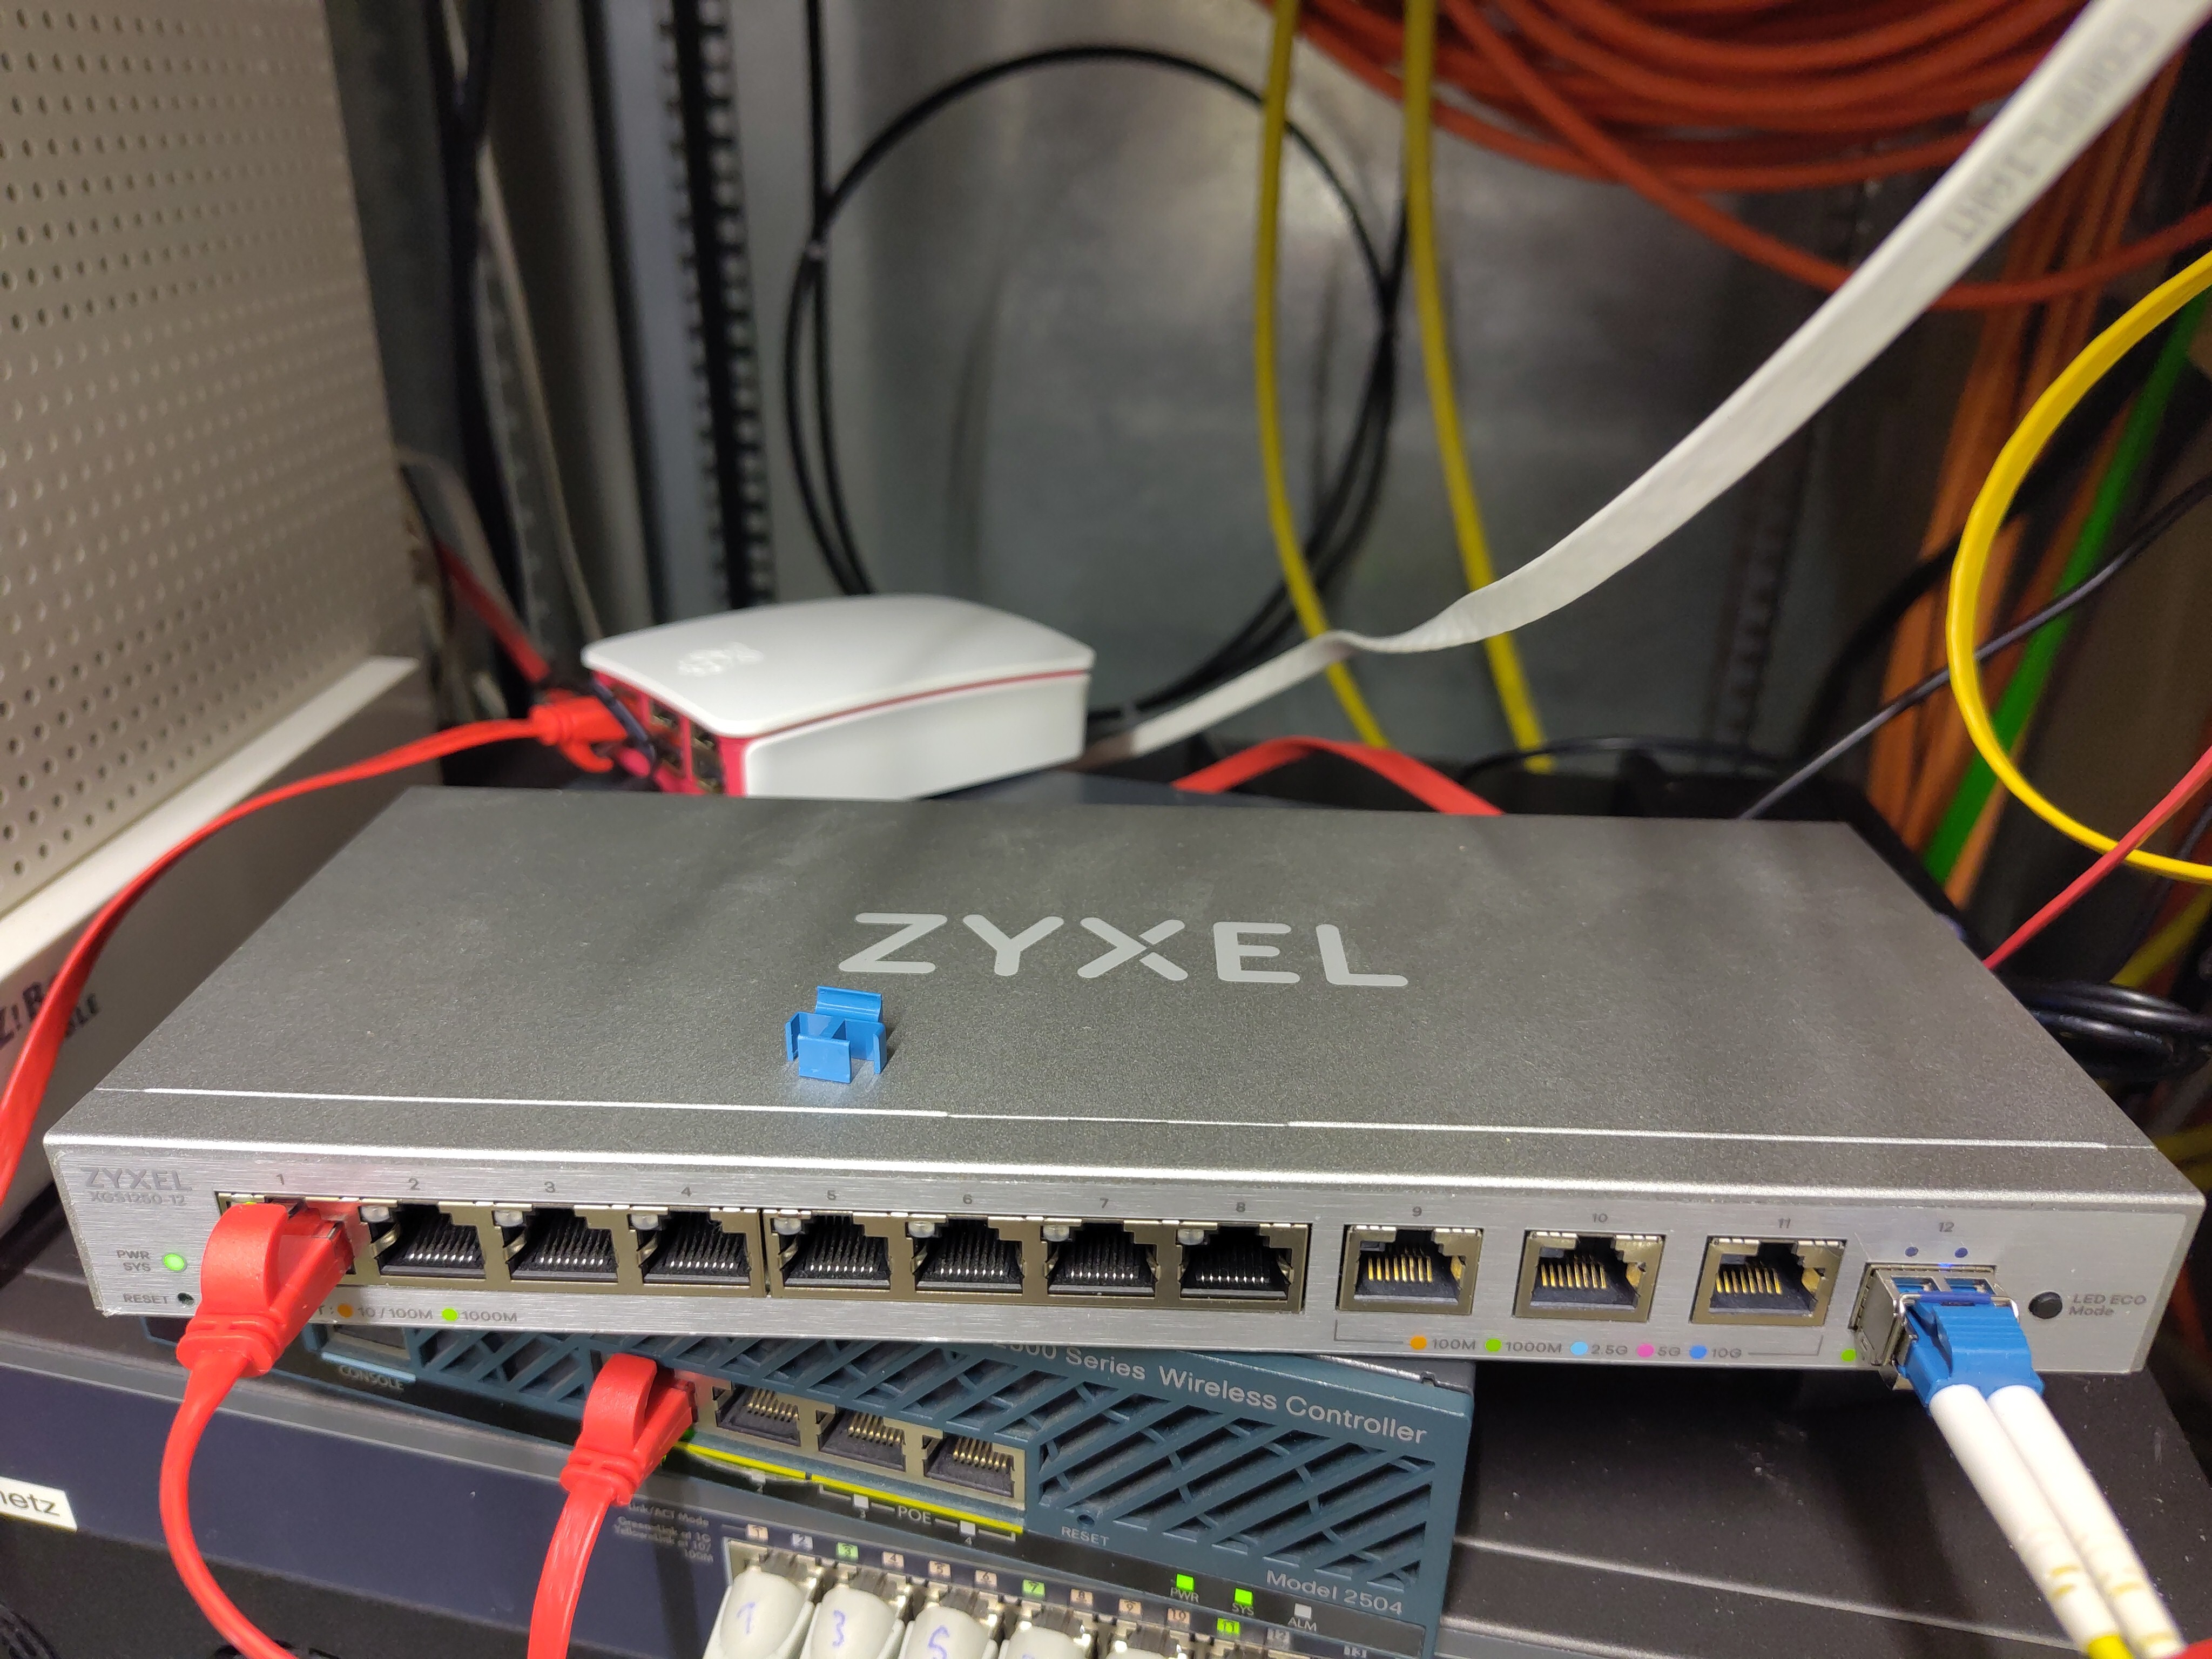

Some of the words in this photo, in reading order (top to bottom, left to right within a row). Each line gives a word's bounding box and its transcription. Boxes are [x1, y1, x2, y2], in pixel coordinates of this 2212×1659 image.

[838, 912, 1409, 987] ZYXEL
[80, 1167, 192, 1191] ZYXEL
[277, 1173, 285, 1185] 1
[408, 1178, 421, 1191] 2
[545, 1181, 556, 1194] 3
[681, 1186, 692, 1197] 4
[827, 1190, 837, 1202] 5
[962, 1193, 973, 1205] 6
[1100, 1197, 1109, 1209] 7
[1236, 1201, 1246, 1213] 8
[1412, 1206, 1422, 1217] 9
[1592, 1212, 1608, 1223] 10
[1778, 1218, 1791, 1229] 11
[1939, 1222, 1955, 1232] 12
[116, 1249, 150, 1259] PWR
[123, 1262, 151, 1272] SYS
[123, 1293, 169, 1304] RESET
[2074, 1294, 2106, 1304] LED
[2110, 1294, 2147, 1305] ECO
[462, 1310, 517, 1323] 1000M
[2069, 1305, 2114, 1316] Mode
[1432, 1339, 1476, 1350] 100M
[1506, 1341, 1562, 1354] 1000M
[1591, 1344, 1628, 1356] 2.5G
[1658, 1347, 1681, 1357] 5G
[1712, 1348, 1742, 1359] 10G
[338, 1365, 404, 1391] CONSOLE
[1065, 1346, 1146, 1380] Series
[1158, 1365, 1277, 1411] Wireless
[1285, 1395, 1427, 1445] Controller
[898, 1506, 932, 1524] POE
[1061, 1526, 1109, 1546] RESET
[1170, 1587, 1199, 1603] PWR
[1266, 1569, 1337, 1600] Model
[1344, 1589, 1403, 1616] 2504
[1232, 1602, 1255, 1616] SYS
[831, 1609, 846, 1648] 3
[1288, 1616, 1317, 1632] ALM
